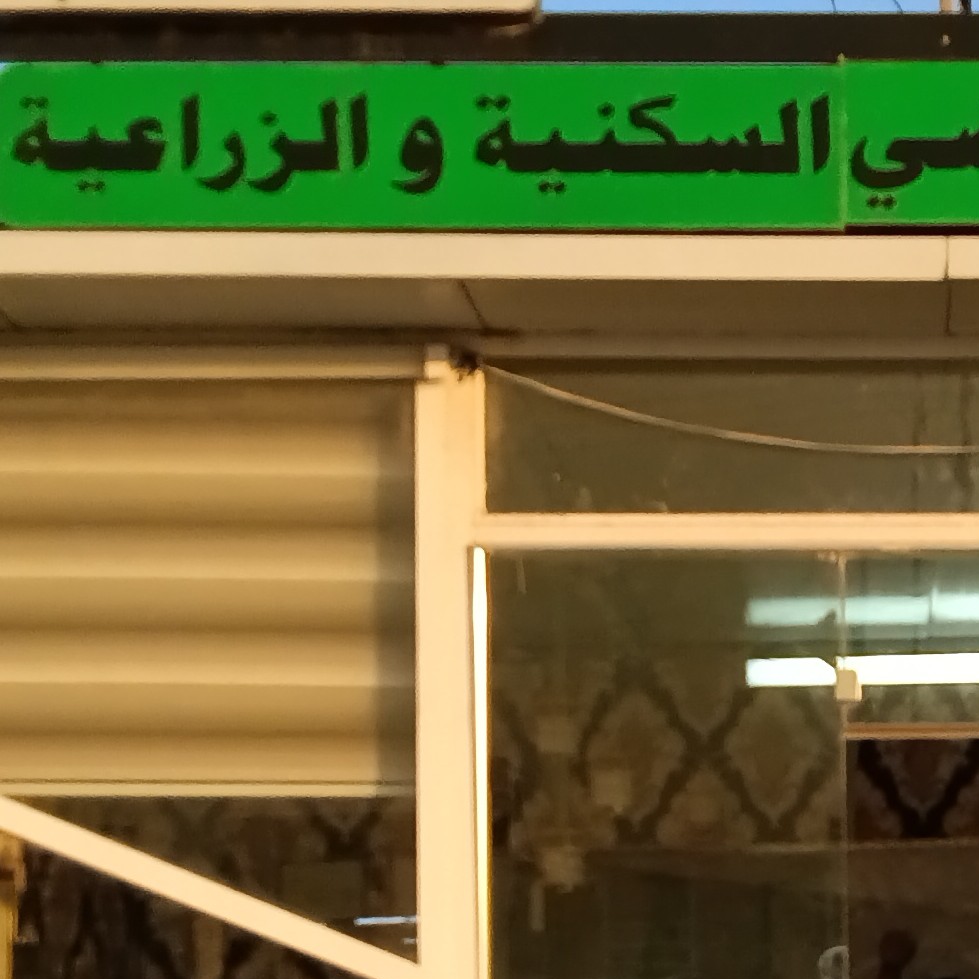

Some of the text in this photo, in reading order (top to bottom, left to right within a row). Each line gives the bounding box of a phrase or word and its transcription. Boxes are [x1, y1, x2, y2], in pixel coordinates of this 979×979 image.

[12, 94, 370, 194] الزراعية
[393, 116, 445, 196] و
[474, 95, 831, 194] السكنية
